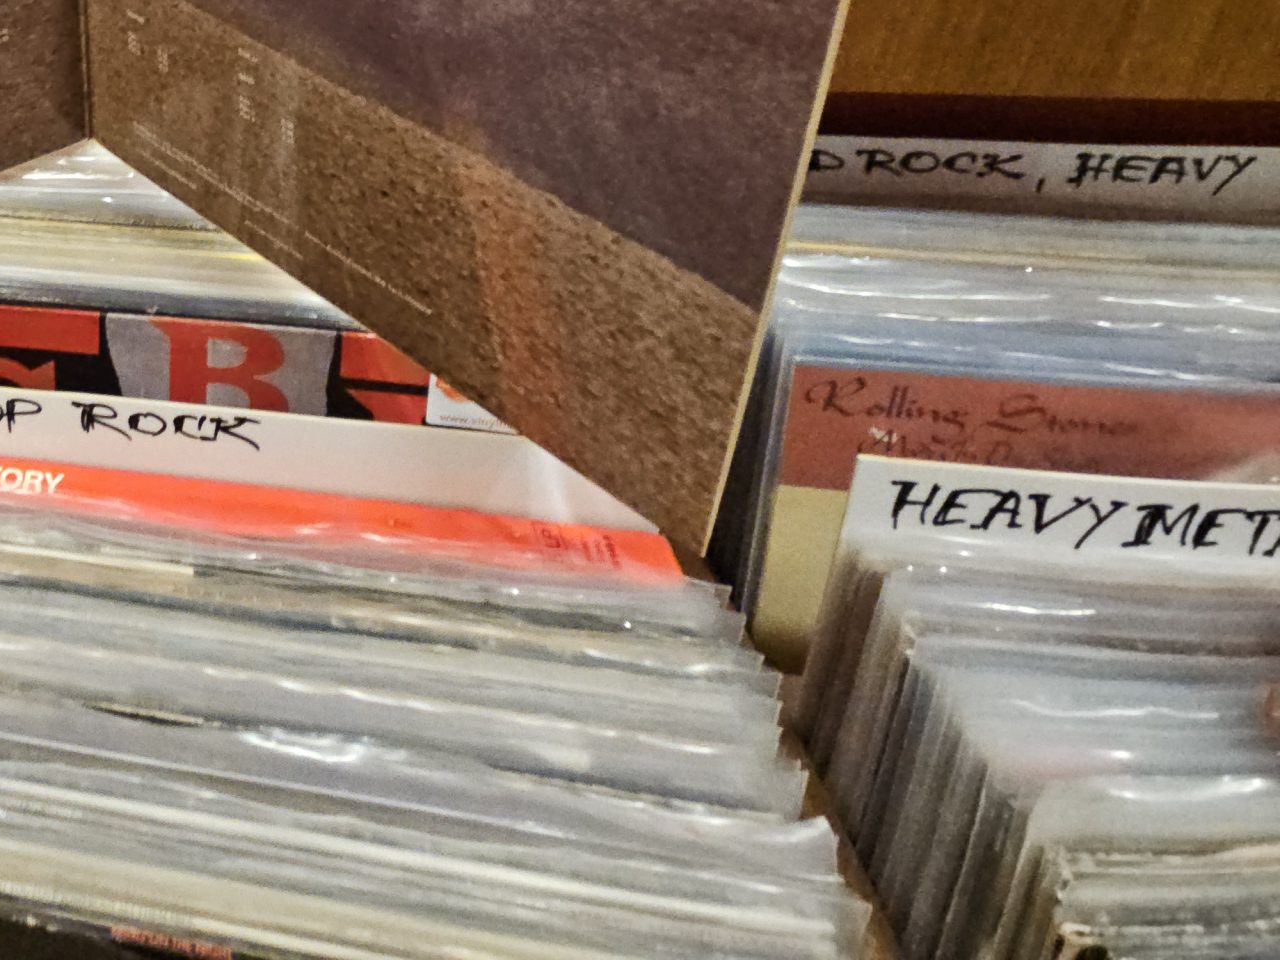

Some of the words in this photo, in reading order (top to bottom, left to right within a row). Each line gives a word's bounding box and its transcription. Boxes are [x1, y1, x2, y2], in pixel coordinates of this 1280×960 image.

[1066, 150, 1257, 196] HEAVY
[71, 401, 261, 451] ROCK
[891, 478, 1126, 550] HEAVY
